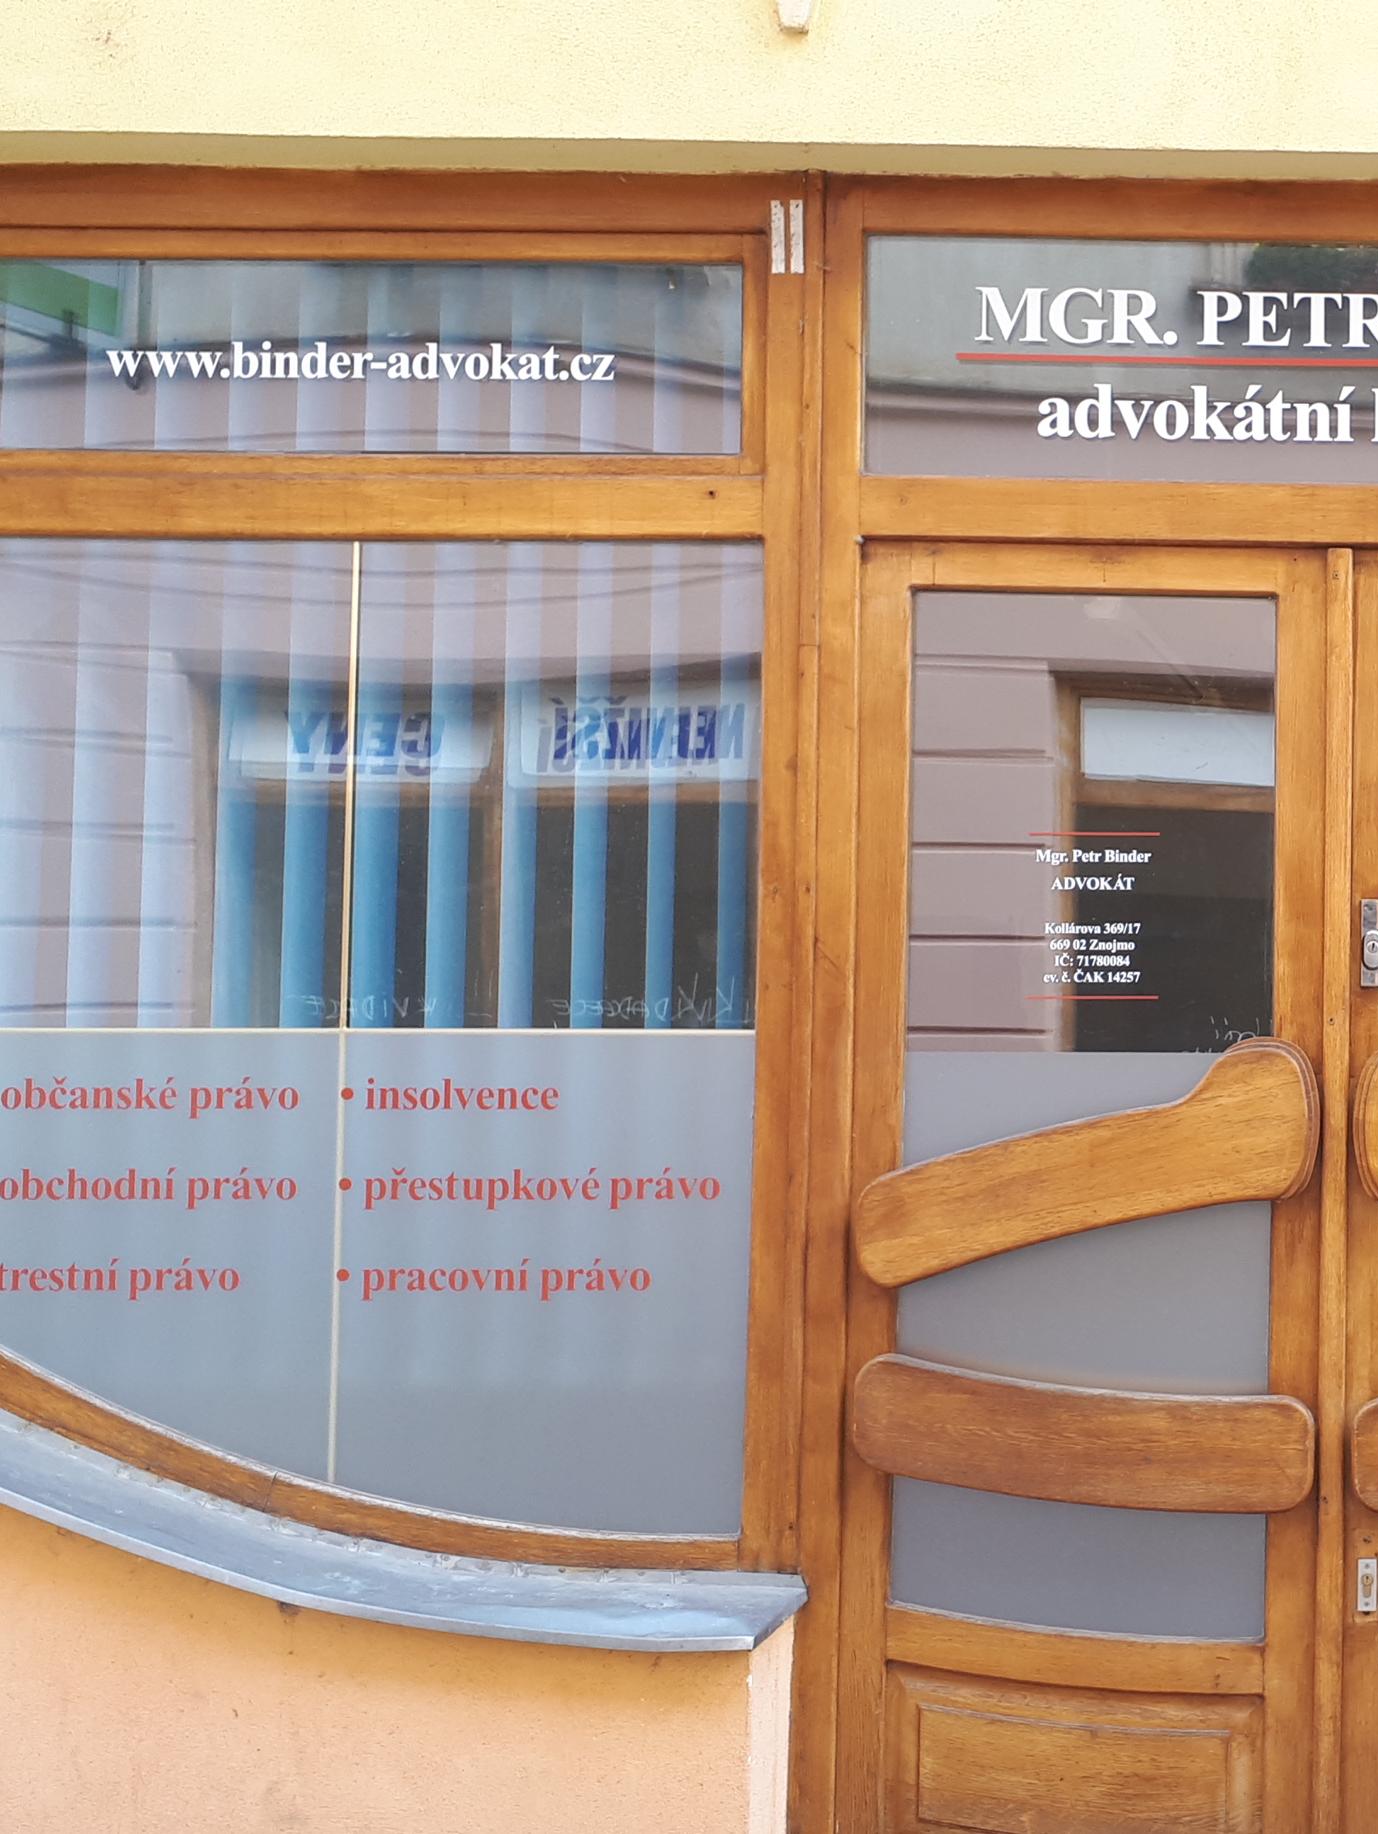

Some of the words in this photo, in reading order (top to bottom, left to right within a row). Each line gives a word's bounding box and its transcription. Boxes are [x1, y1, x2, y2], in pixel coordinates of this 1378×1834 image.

[974, 286, 1178, 345] MGR.
[106, 341, 615, 381] www.binder-advokat.cz
[1037, 383, 1356, 442] advokátní
[1035, 849, 1069, 866] Mgr.
[1072, 849, 1102, 863] Petr
[1105, 849, 1152, 863] Binder
[1050, 873, 1135, 890] ADVOKÁT
[1044, 922, 1101, 934] Kollárova
[1103, 923, 1141, 934] 369/17
[1049, 939, 1071, 950] 669
[1072, 939, 1087, 950] 02
[1089, 939, 1135, 953] Znojmo
[1043, 974, 1059, 983] ev.
[1061, 971, 1071, 983] č.
[1073, 969, 1104, 983] ČAK
[1108, 971, 1141, 983] 14257
[1054, 952, 1074, 967] IČ:
[1076, 955, 1130, 967] 71780084
[1, 1077, 178, 1111] občanské
[190, 1077, 301, 1120] právo
[366, 1077, 561, 1112] insolvence
[0, 1167, 177, 1201] obchodní
[187, 1167, 299, 1211] právo
[364, 1167, 602, 1212] přestupkové
[609, 1167, 722, 1212] právo
[0, 1257, 119, 1293] trestní
[129, 1258, 241, 1303] právo
[362, 1258, 530, 1302] pracovní
[539, 1257, 653, 1303] právo
